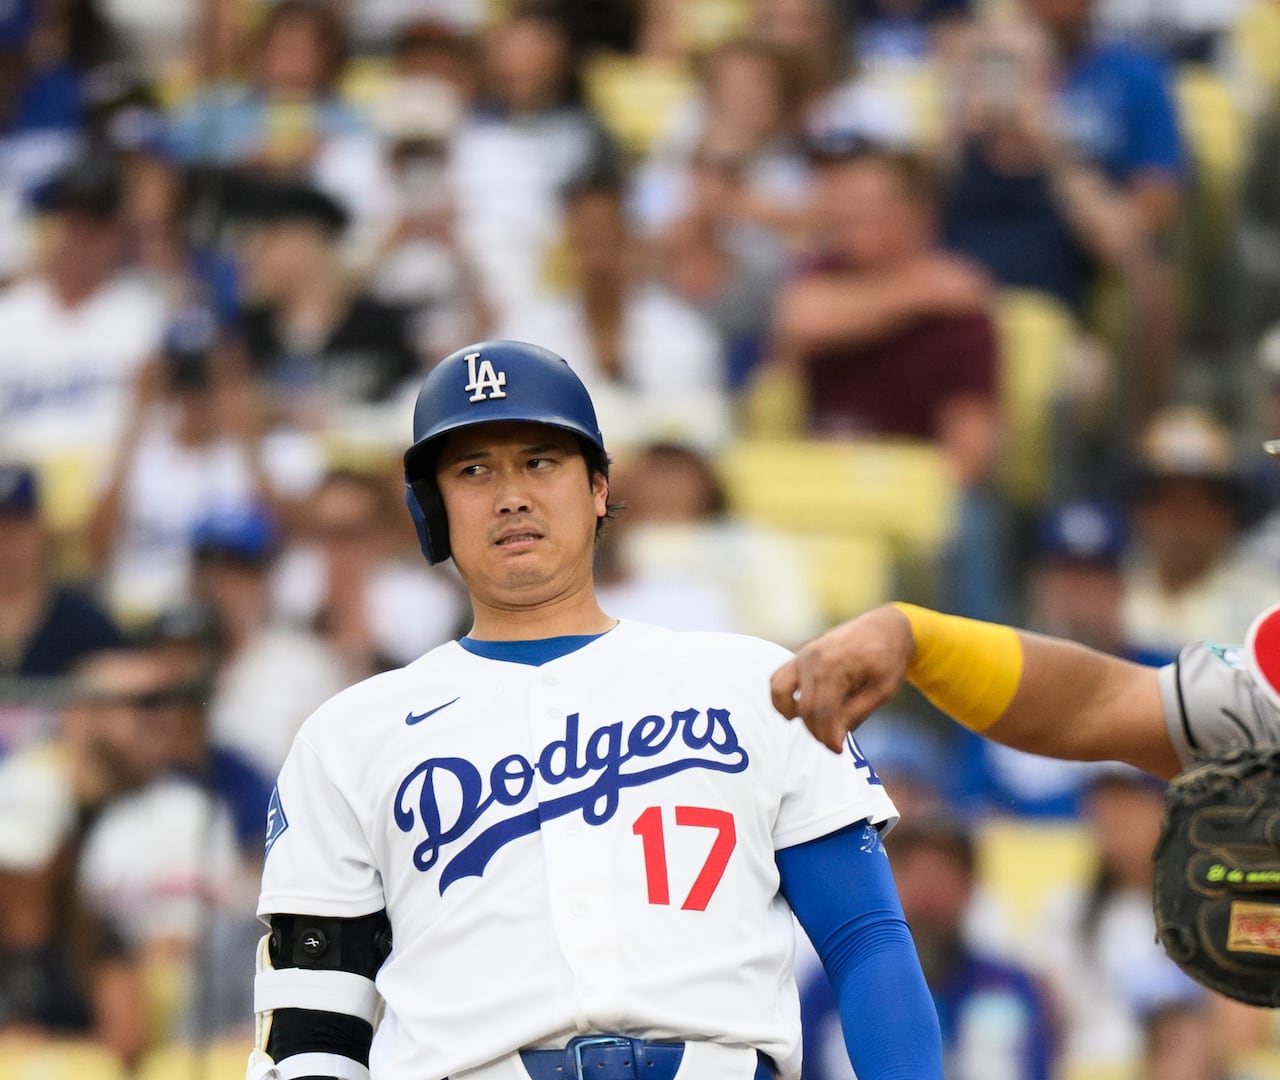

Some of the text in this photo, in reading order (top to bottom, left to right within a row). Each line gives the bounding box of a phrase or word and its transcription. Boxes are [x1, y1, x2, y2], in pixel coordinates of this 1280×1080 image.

[463, 352, 507, 402] LA
[394, 707, 749, 897] Dodgers
[632, 806, 737, 912] 17
